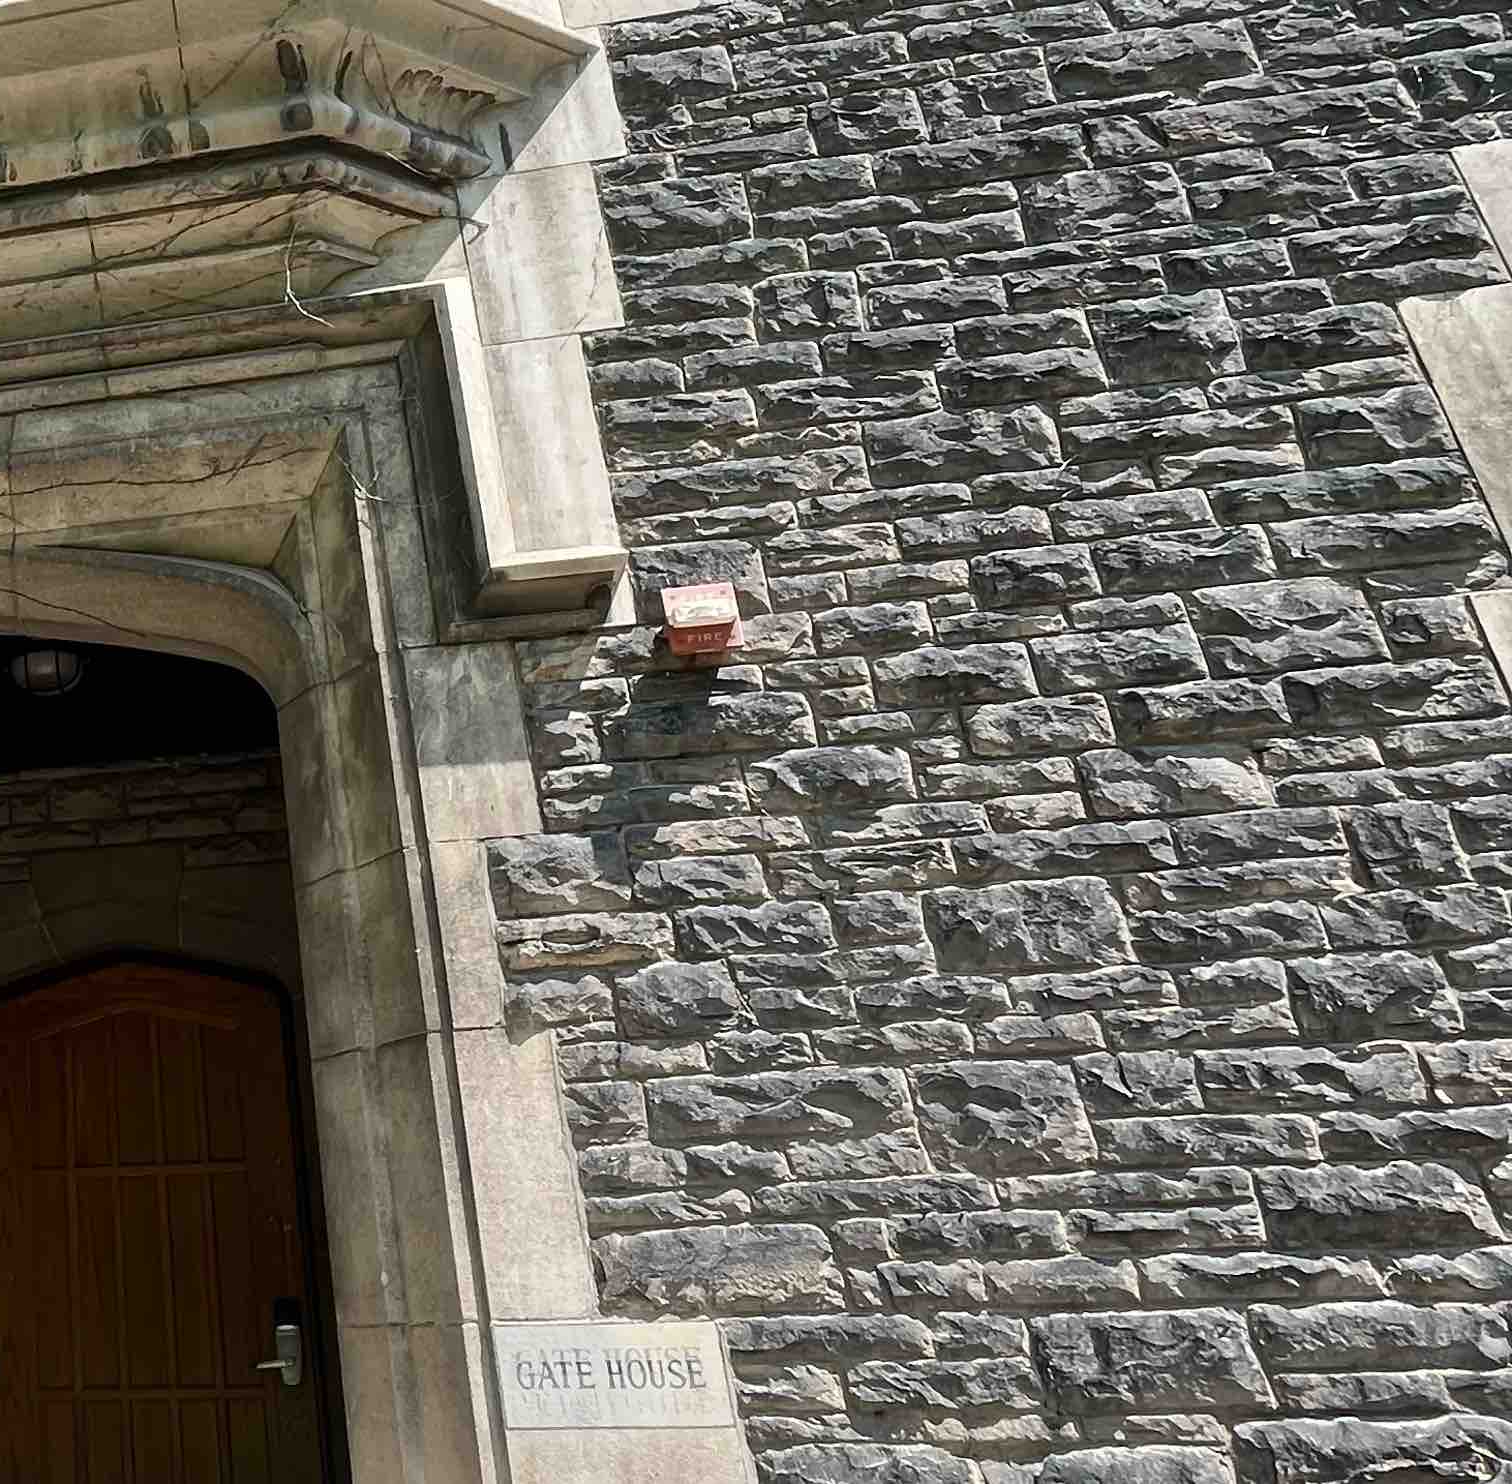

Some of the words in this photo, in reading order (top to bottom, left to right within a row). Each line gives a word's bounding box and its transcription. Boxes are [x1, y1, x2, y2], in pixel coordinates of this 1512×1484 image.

[687, 631, 723, 644] FIRE
[516, 1360, 596, 1390] GATE
[605, 1359, 707, 1389] HOUSE
